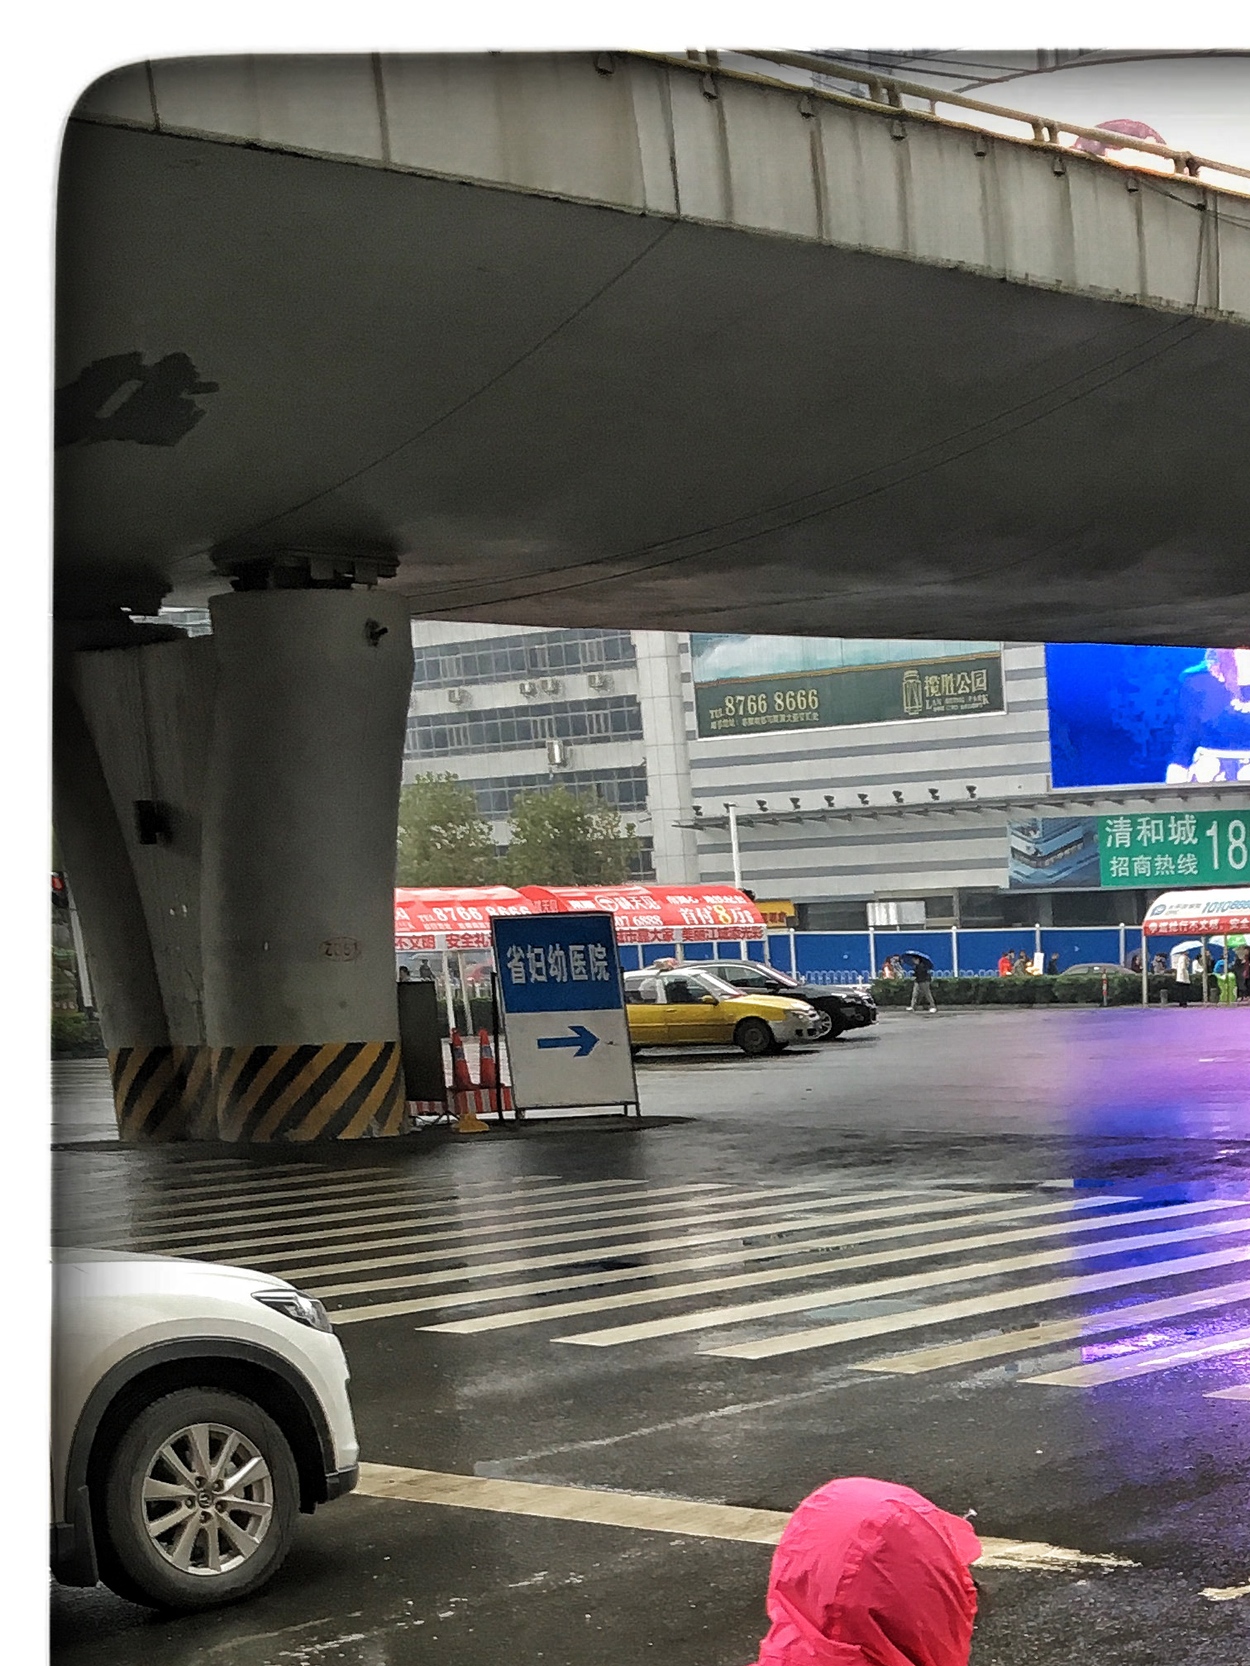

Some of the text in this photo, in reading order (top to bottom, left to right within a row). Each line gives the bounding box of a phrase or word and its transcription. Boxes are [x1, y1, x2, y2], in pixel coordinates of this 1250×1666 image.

[725, 693, 768, 716] 8766
[774, 689, 819, 712] 8666
[1105, 814, 1199, 849] 清和城
[1109, 853, 1199, 878] 招商热线
[432, 906, 484, 922] 8766
[506, 942, 611, 985] 省妇幼医院
